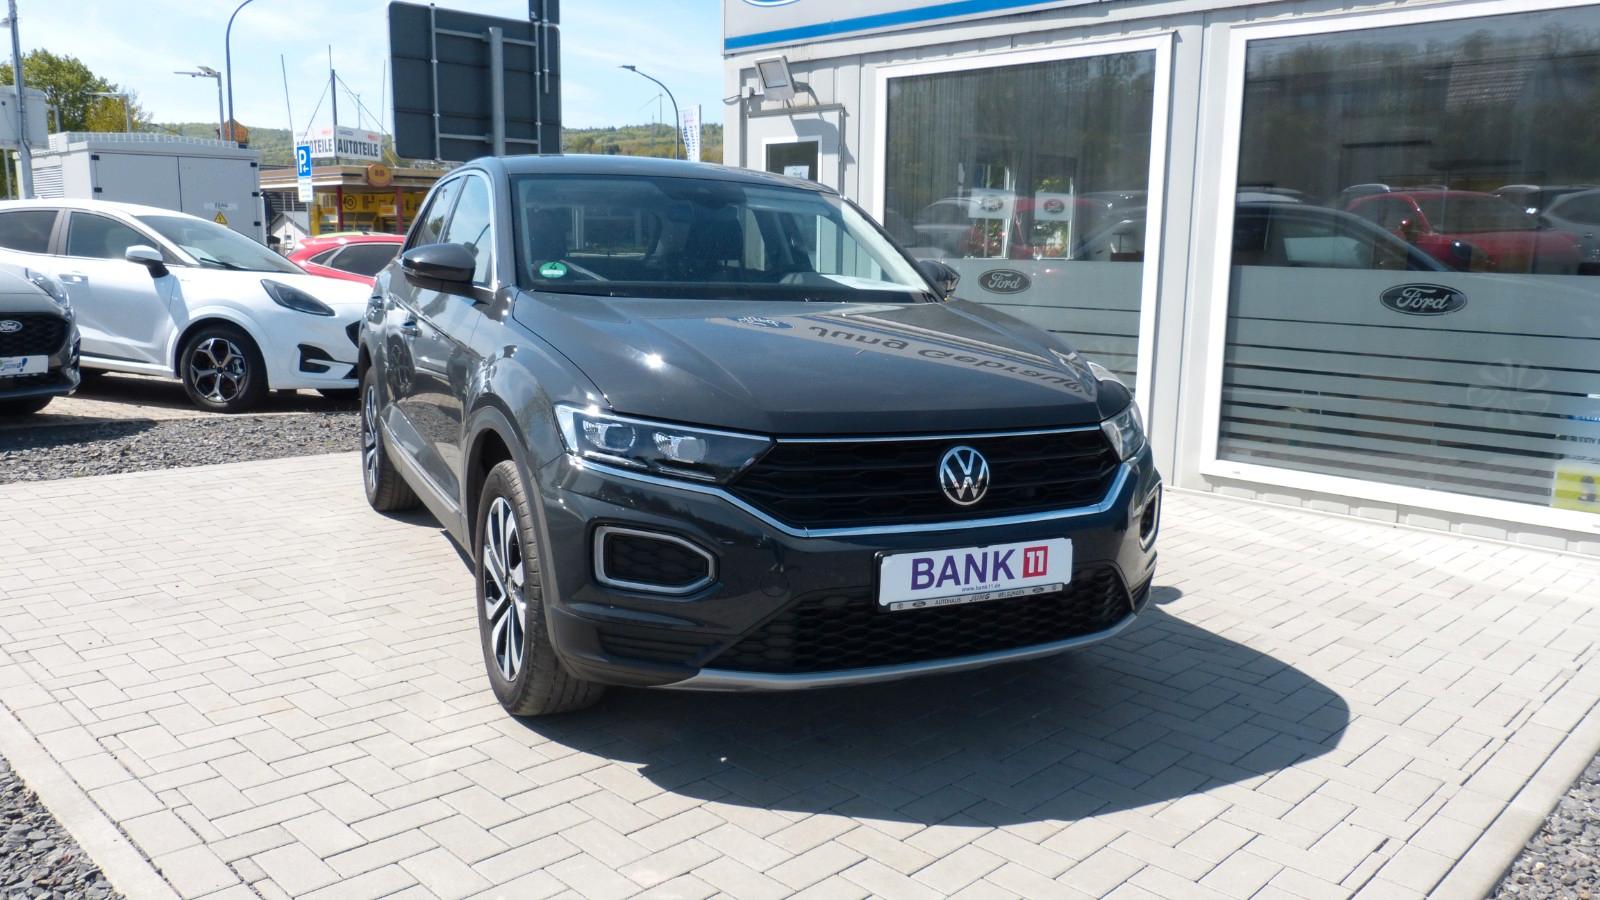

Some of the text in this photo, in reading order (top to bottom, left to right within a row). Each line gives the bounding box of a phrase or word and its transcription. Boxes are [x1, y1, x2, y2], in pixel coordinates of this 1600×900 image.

[337, 139, 379, 158] AUTOTEILE
[298, 149, 307, 174] P
[987, 273, 1021, 290] Ford
[1396, 287, 1449, 311] Ford
[910, 548, 1047, 591] BANK 11
[934, 597, 962, 606] AUTOHAUS
